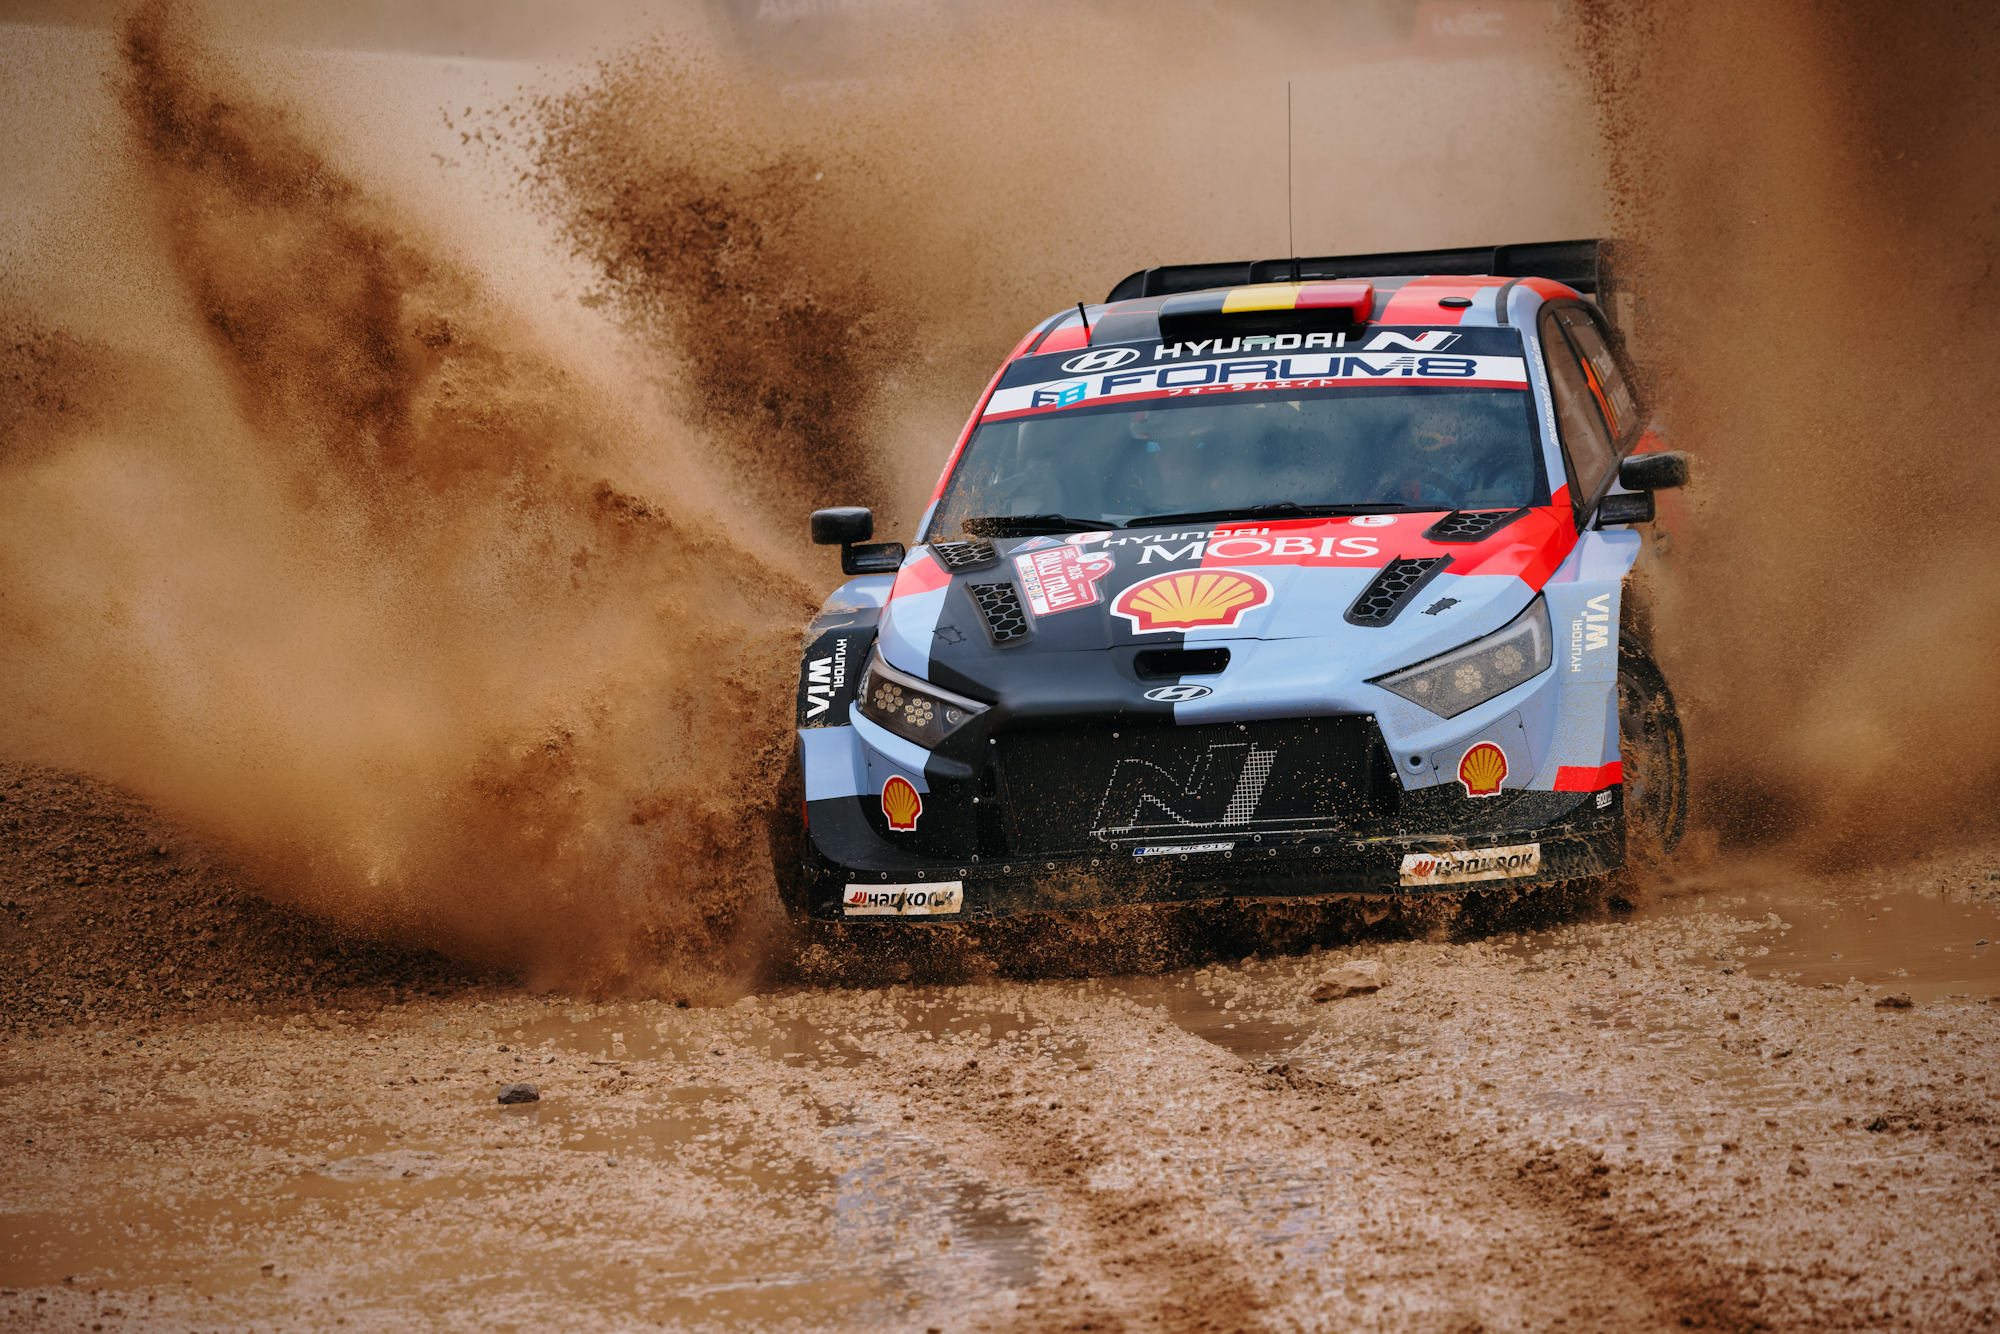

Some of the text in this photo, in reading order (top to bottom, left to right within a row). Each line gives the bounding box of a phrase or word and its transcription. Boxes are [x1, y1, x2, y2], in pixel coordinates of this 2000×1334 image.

[1154, 332, 1346, 360] HYUNDAI
[1100, 356, 1477, 395] FORUM8
[1168, 379, 1332, 396] フォーラムエイト
[1103, 527, 1269, 548] HYUNDAI
[1137, 537, 1380, 564] MOBIS
[1033, 551, 1063, 576] RALLY
[1020, 565, 1044, 601] SARDEGNA
[1042, 575, 1077, 607] ITALIA
[1571, 619, 1582, 673] HYUNDAI
[834, 638, 847, 688] HYUNDAI
